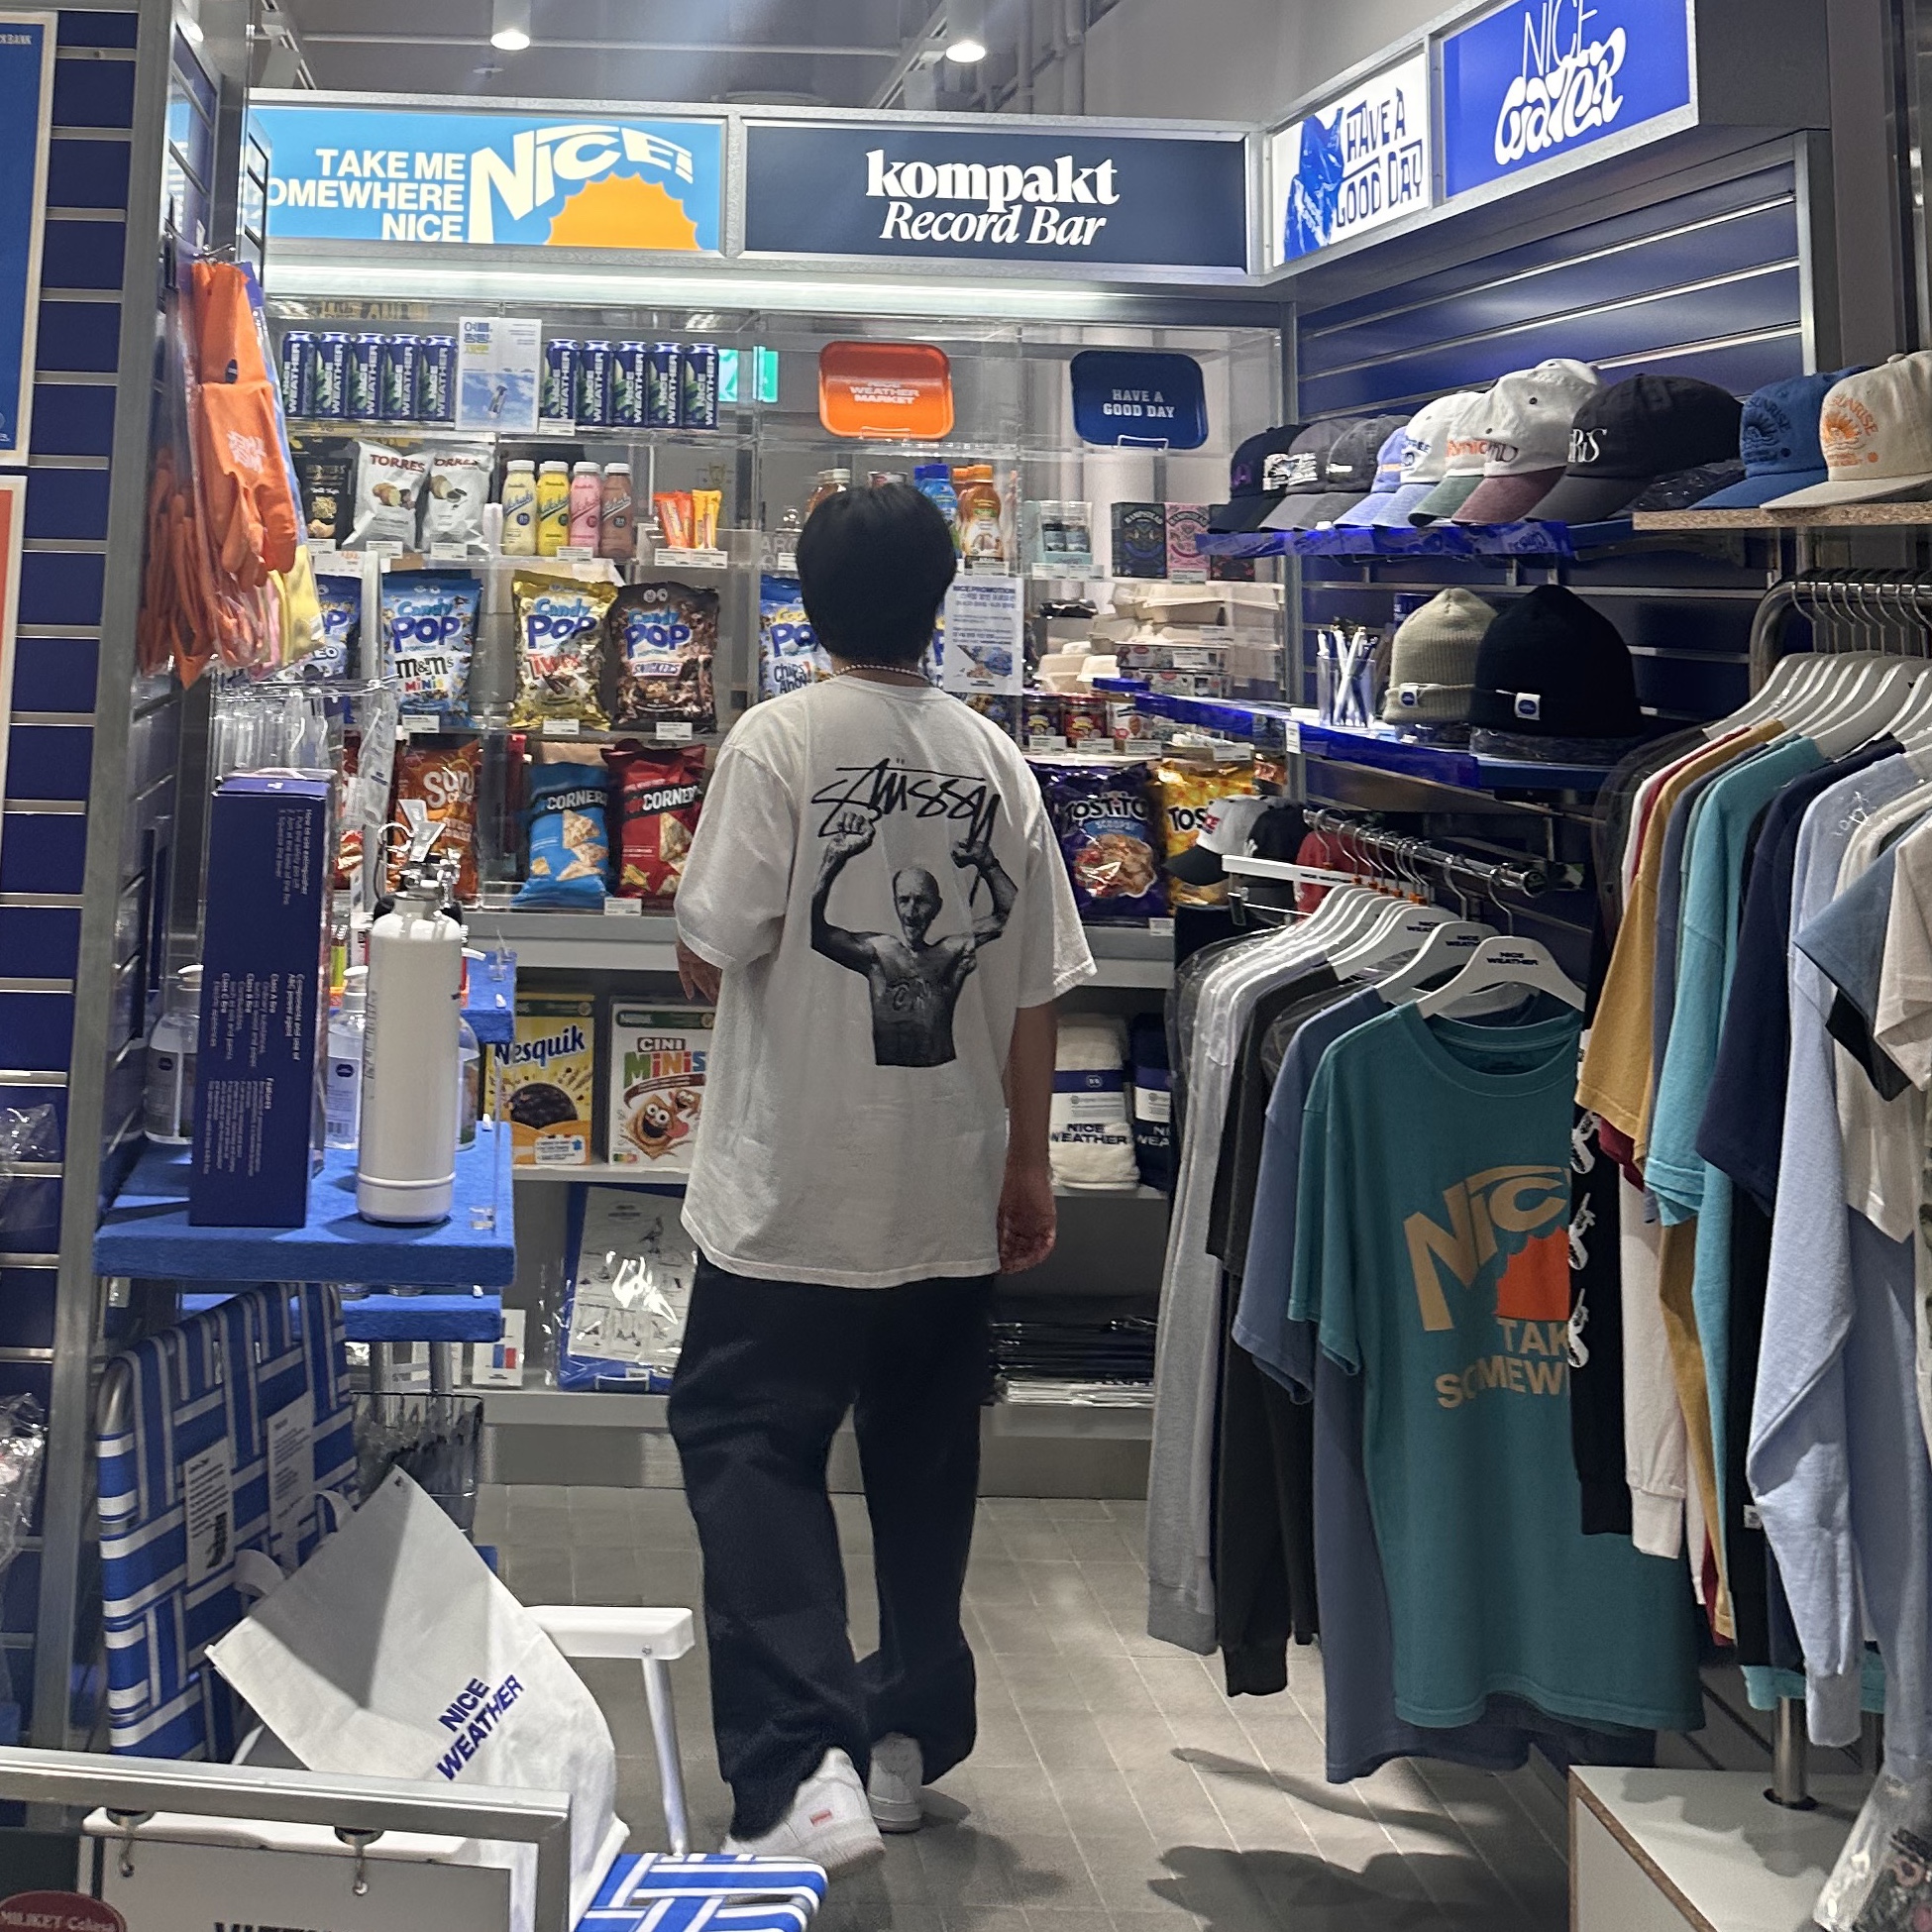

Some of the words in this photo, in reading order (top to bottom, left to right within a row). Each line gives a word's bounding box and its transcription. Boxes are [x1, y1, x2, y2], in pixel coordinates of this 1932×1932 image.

[315, 149, 408, 179] TAKE
[416, 151, 466, 181] ME
[865, 149, 1121, 213] kompakt
[382, 213, 465, 243] NICE
[880, 201, 1020, 244] Record
[1025, 206, 1108, 247] Bar
[290, 343, 300, 413] WEATHER
[332, 344, 343, 414] WEATHER
[368, 345, 377, 414] WEATHER
[402, 346, 413, 415] WEATHER
[437, 347, 447, 416] WEATHER
[594, 352, 603, 422] WEATHER
[634, 354, 644, 423] WEATHER
[667, 354, 677, 424] WEATHER
[704, 355, 715, 425] WEATHER
[1112, 388, 1149, 402] HAVE
[1153, 390, 1164, 402] A
[1103, 402, 1142, 416] GOOD
[1146, 404, 1175, 418] DAY
[370, 454, 426, 474] TORRES
[397, 597, 454, 616] Candy
[535, 597, 590, 617] Candy
[423, 770, 476, 808] Sun
[1486, 956, 1539, 966] WEATHER
[495, 1024, 586, 1068] Nesquik
[639, 1038, 684, 1051] CINI
[1066, 1123, 1107, 1133] NICE
[436, 1674, 525, 1781] WEATHER
[438, 1677, 490, 1733] NICE
